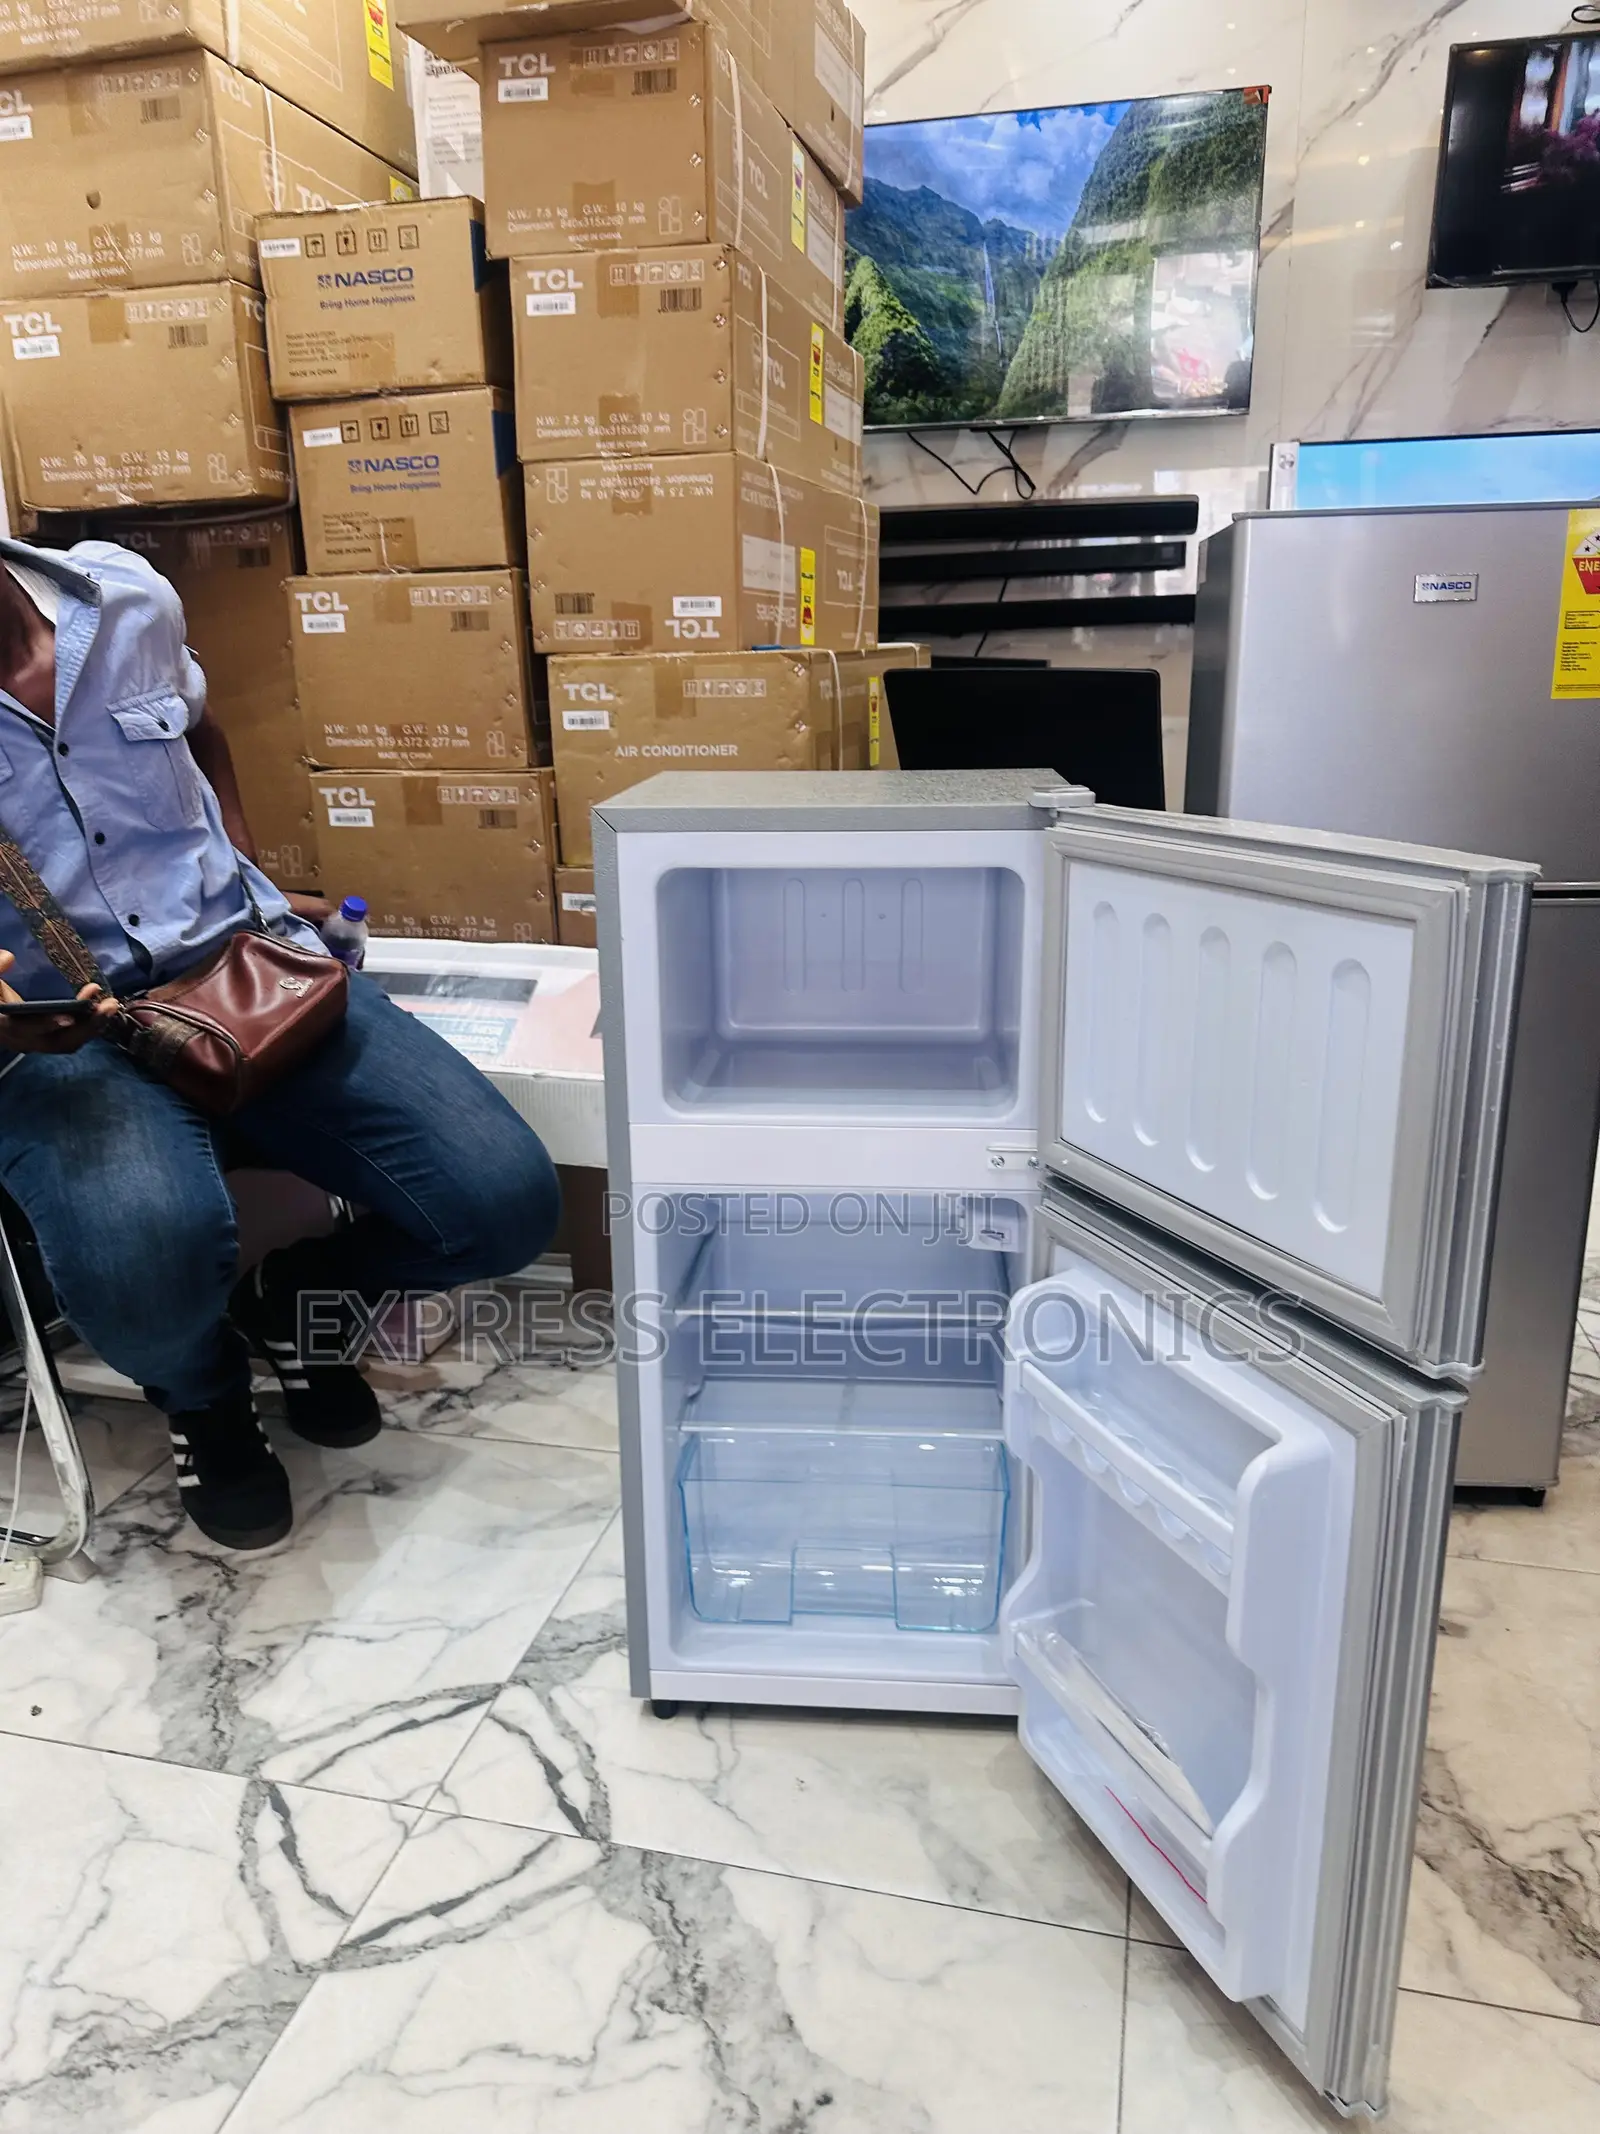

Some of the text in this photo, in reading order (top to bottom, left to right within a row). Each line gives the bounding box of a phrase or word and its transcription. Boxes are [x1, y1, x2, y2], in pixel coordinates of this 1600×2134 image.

[499, 53, 556, 77] TCL
[748, 157, 769, 200] TCL
[615, 202, 627, 213] 10
[633, 201, 645, 213] kg
[628, 215, 646, 225] mm
[335, 267, 413, 288] NASCO
[526, 268, 584, 291] TCL
[241, 296, 264, 323] TC
[320, 294, 415, 311] Bring Home Happiness
[3, 311, 62, 336] TCL
[642, 412, 652, 422] 10
[659, 411, 670, 423] kg
[654, 425, 671, 434] mm
[364, 455, 439, 473] NASCO
[114, 532, 160, 549] TCL
[1430, 581, 1472, 590] NASCO
[294, 591, 349, 612] TCL
[665, 619, 720, 639] TCL
[563, 683, 614, 701] TCL
[356, 724, 368, 734] 10
[375, 724, 387, 737] kg
[437, 724, 449, 735] 13
[455, 724, 468, 737] kg
[451, 739, 470, 748] mm
[614, 744, 739, 757] AIR CONDITIONER
[318, 787, 377, 807] TCL
[384, 915, 396, 924] 10
[403, 915, 415, 926] kg
[464, 916, 478, 925] 13
[483, 916, 496, 928] kg
